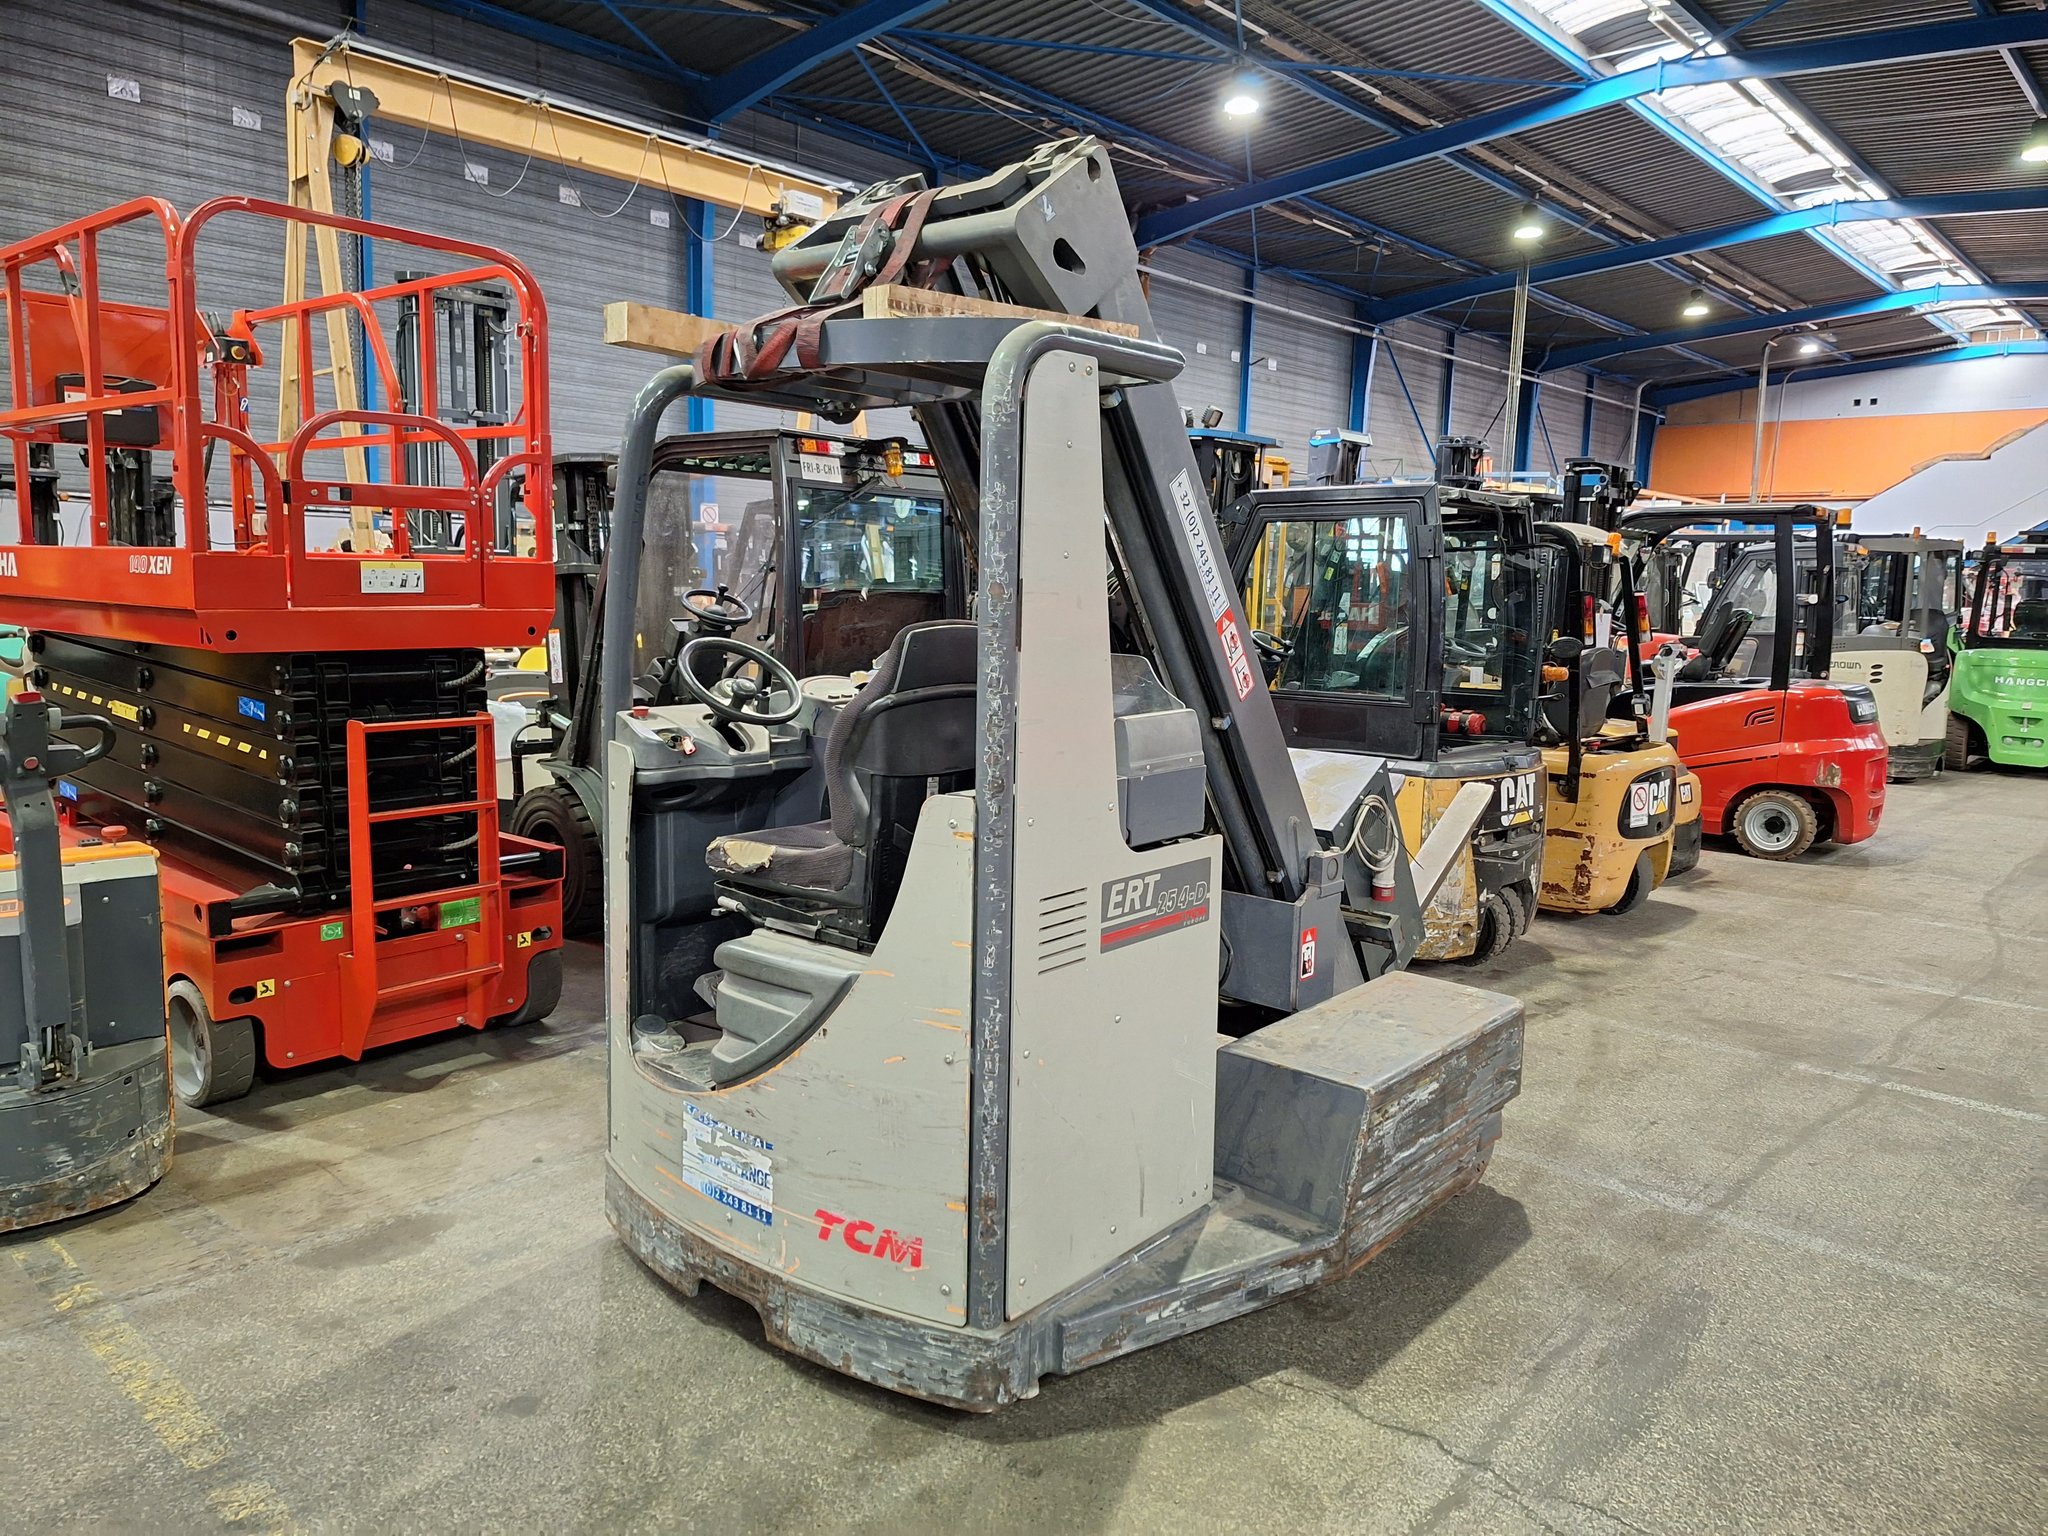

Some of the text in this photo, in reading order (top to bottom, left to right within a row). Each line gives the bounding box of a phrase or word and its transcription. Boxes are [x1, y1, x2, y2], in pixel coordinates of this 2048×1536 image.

[802, 461, 841, 476] FRI-B-CH11
[1179, 491, 1191, 509] 32
[1185, 511, 1201, 540] (0)2
[1196, 540, 1209, 566] 243
[1204, 566, 1215, 587] 81
[1211, 586, 1221, 604] 11
[1994, 676, 2048, 687] HANGC
[1500, 772, 1537, 827] CAT
[1649, 778, 1671, 816] CAT
[1679, 783, 1692, 803] CAT
[1106, 873, 1161, 918] ERT
[722, 1192, 739, 1209] 243
[741, 1202, 752, 1215] 81
[755, 1210, 768, 1222] 11
[814, 1208, 924, 1268] TCM
